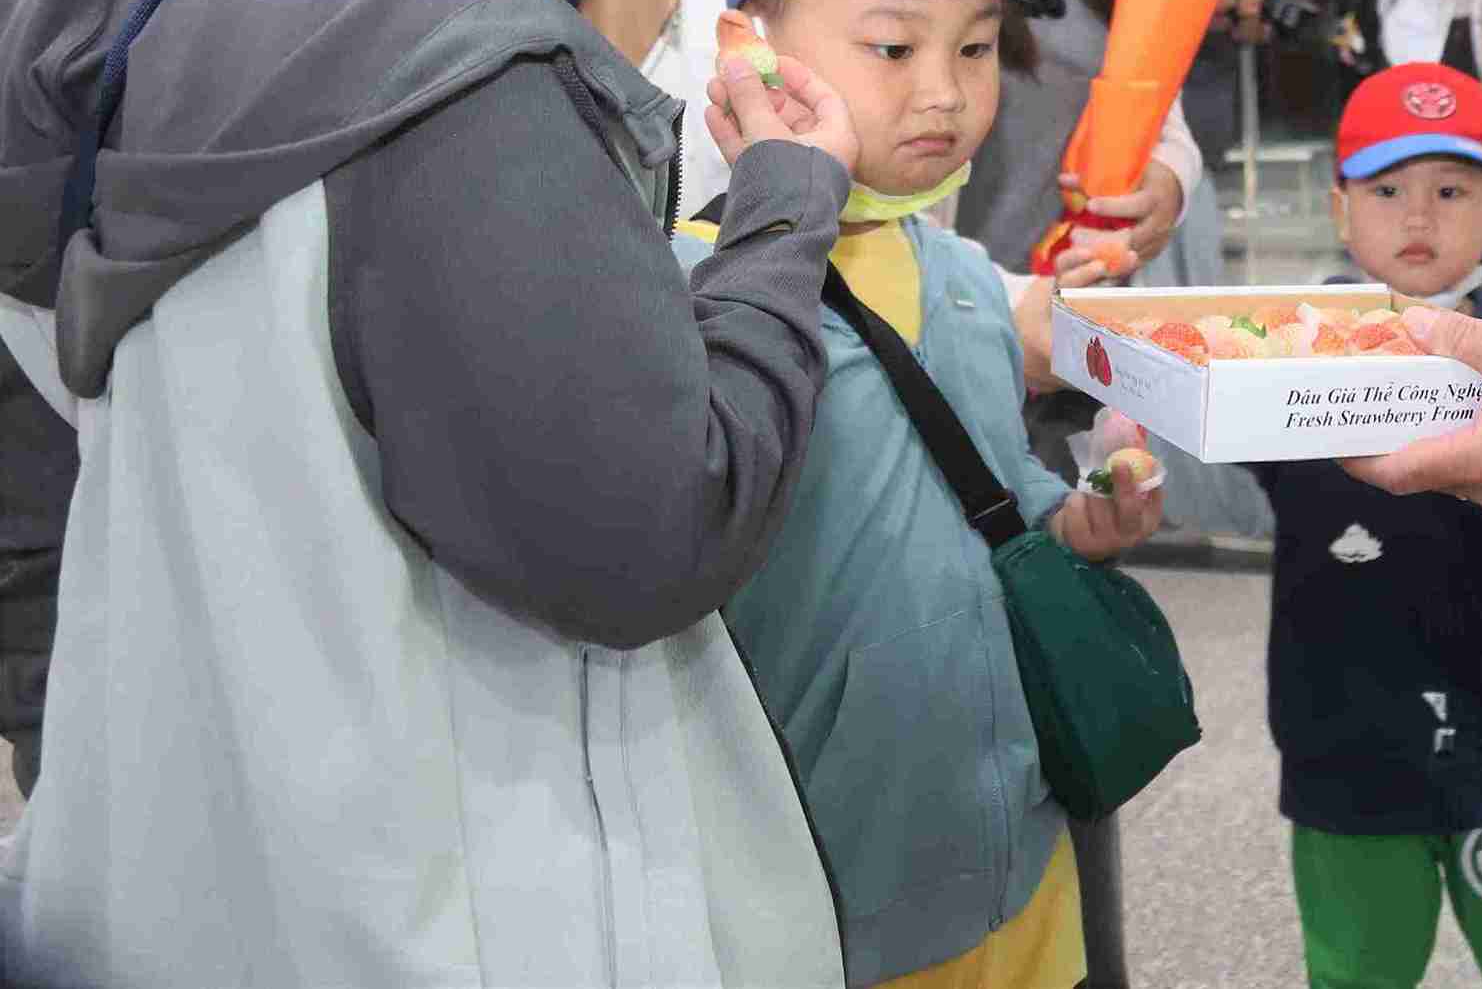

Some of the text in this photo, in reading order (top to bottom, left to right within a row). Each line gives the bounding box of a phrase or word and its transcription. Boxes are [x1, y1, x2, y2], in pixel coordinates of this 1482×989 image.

[1287, 389, 1321, 405] Dâu
[1398, 385, 1439, 403] Công
[1285, 411, 1333, 428] Fresh
[1338, 408, 1426, 426] Strawberry
[1432, 405, 1474, 421] From
